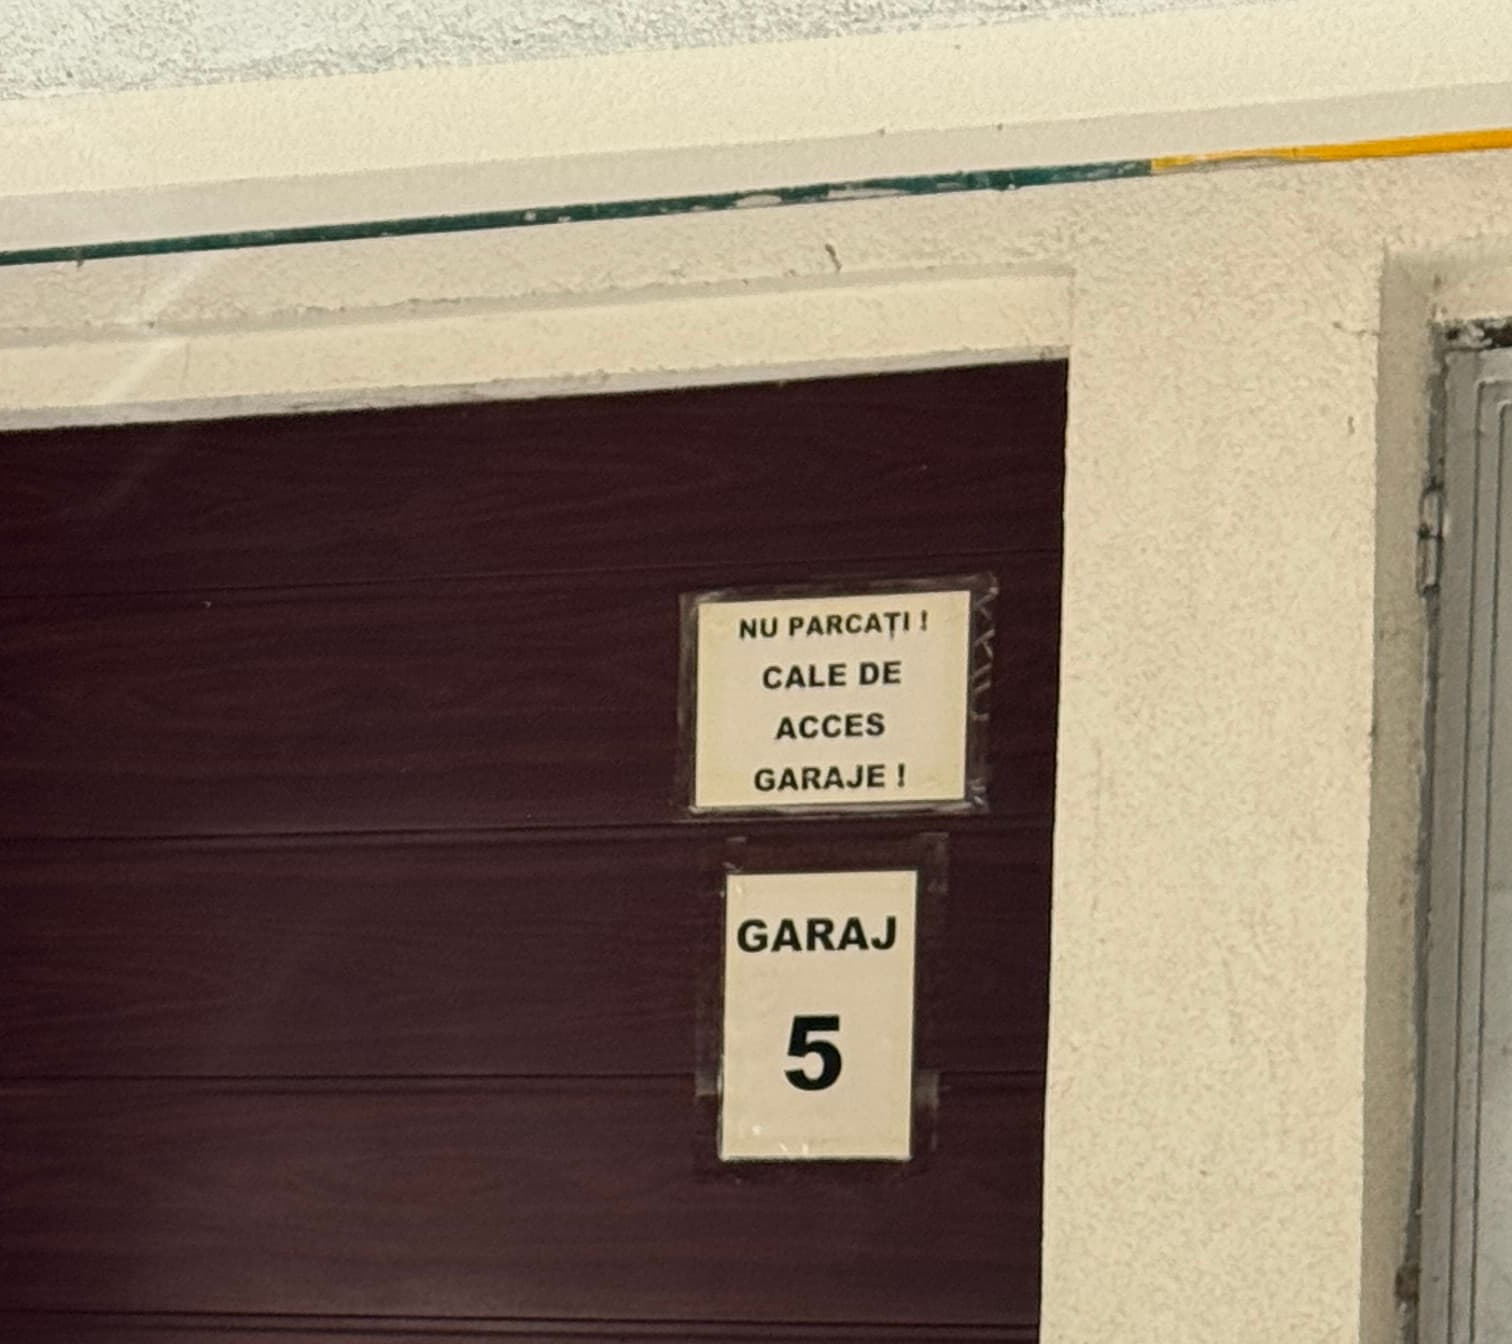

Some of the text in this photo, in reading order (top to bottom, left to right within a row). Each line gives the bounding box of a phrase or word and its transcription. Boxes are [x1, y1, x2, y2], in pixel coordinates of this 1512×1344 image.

[739, 617, 778, 639] NU
[762, 660, 902, 690] CALE DE
[775, 712, 886, 740] ACCES
[754, 764, 886, 792] GARAJE
[737, 916, 897, 953] GARAJ
[784, 1014, 843, 1092] 5
